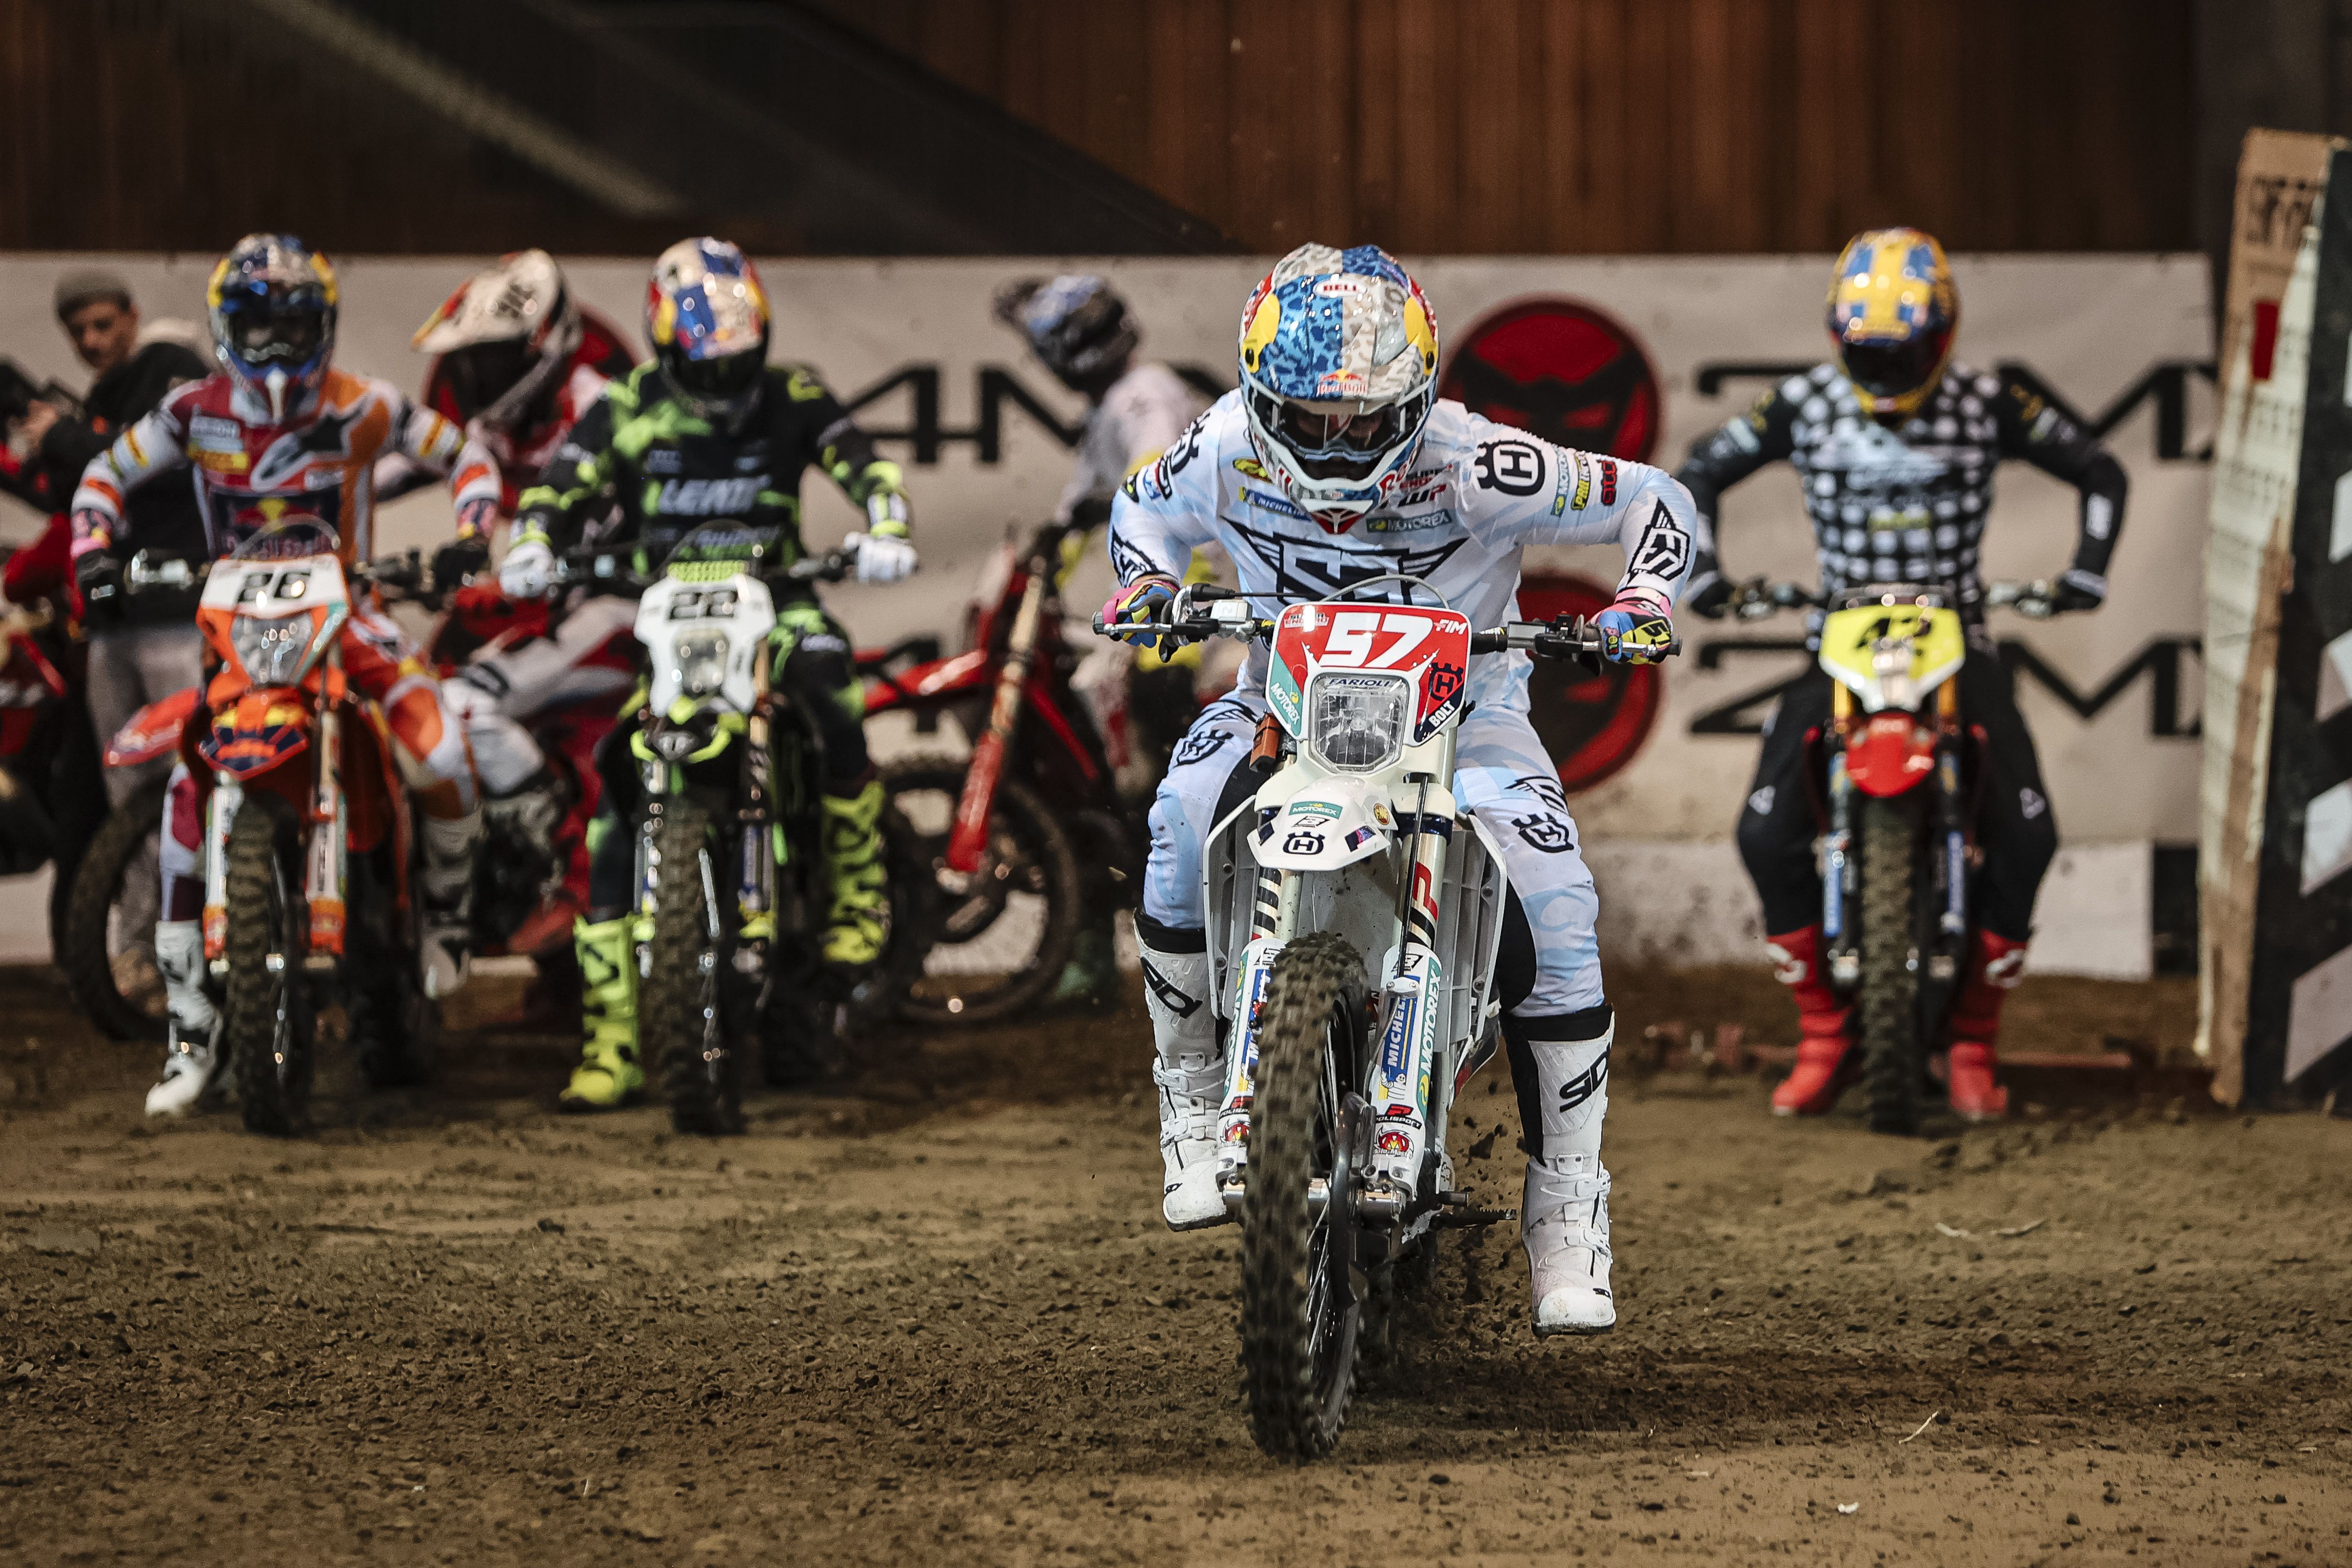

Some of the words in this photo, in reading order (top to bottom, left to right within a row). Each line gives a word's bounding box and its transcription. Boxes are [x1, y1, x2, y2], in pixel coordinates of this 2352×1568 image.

[1388, 511, 1449, 531] MOTOREX
[1435, 619, 1468, 635] FIM
[1319, 612, 1433, 669] 57
[1329, 678, 1391, 687] FARIOLI
[1271, 682, 1302, 725] MOTOREX
[1429, 700, 1455, 728] BOLT
[1292, 806, 1339, 816] MOTOREX
[1387, 996, 1406, 1067] MICHEL
[1421, 968, 1441, 1073] MOTOREX
[1375, 1116, 1421, 1128] OLISPORT
